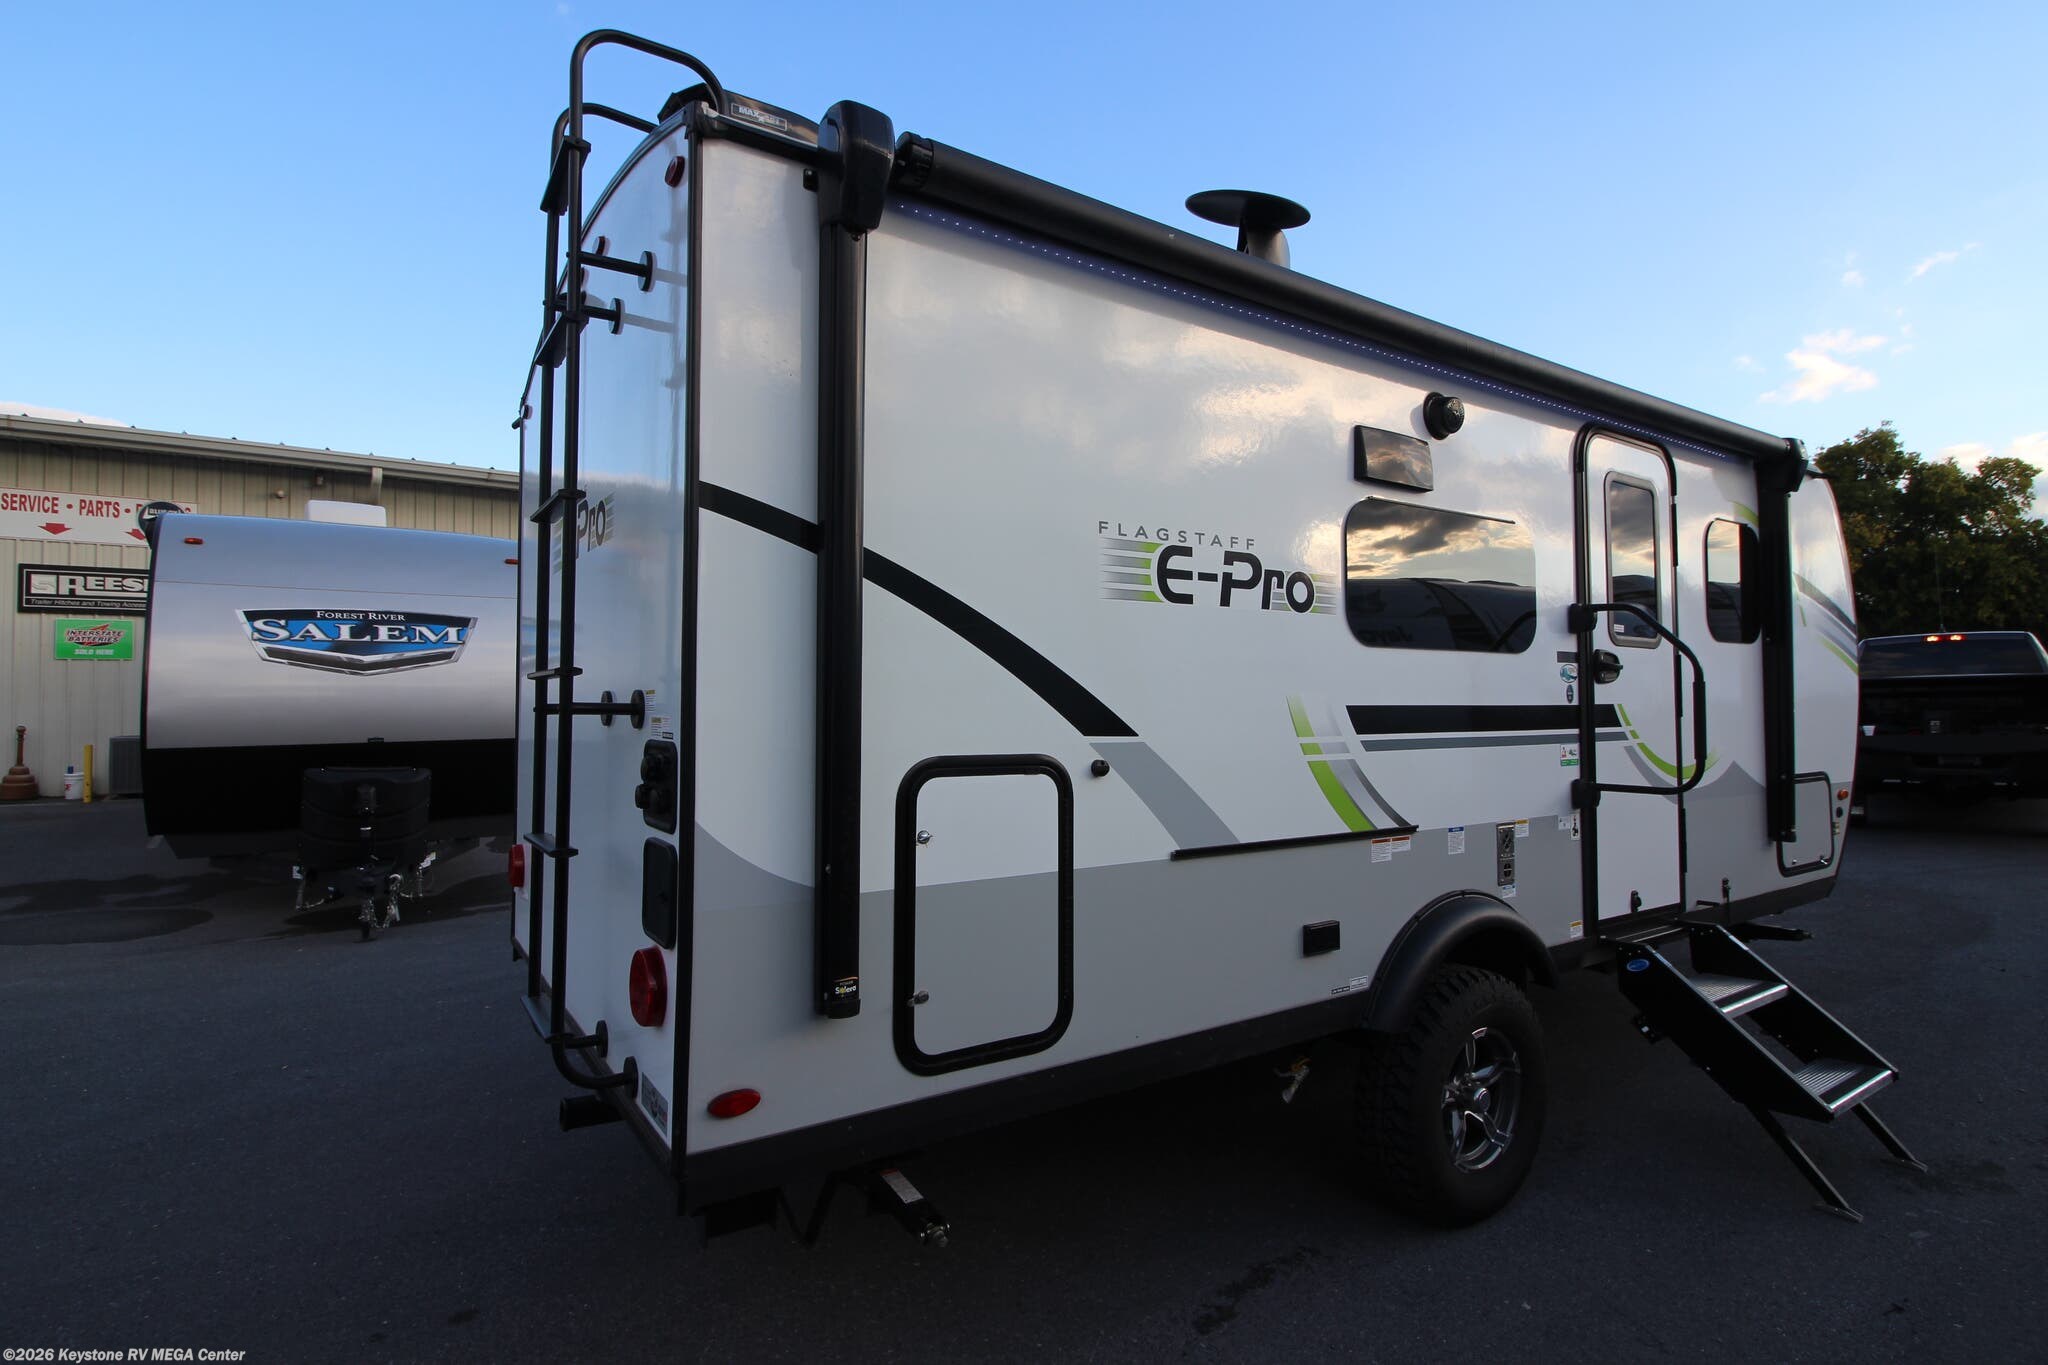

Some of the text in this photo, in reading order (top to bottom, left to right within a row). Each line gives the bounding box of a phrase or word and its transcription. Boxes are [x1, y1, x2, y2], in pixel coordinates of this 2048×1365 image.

[1, 493, 59, 514] SERVICE
[79, 499, 121, 518] PARTS
[1098, 520, 1256, 550] FLAGSTAFF
[1156, 544, 1315, 614] E-Pro
[316, 610, 406, 621] FOREST RIVER
[65, 629, 123, 637] INTERSTATE
[252, 618, 465, 644] SALEM
